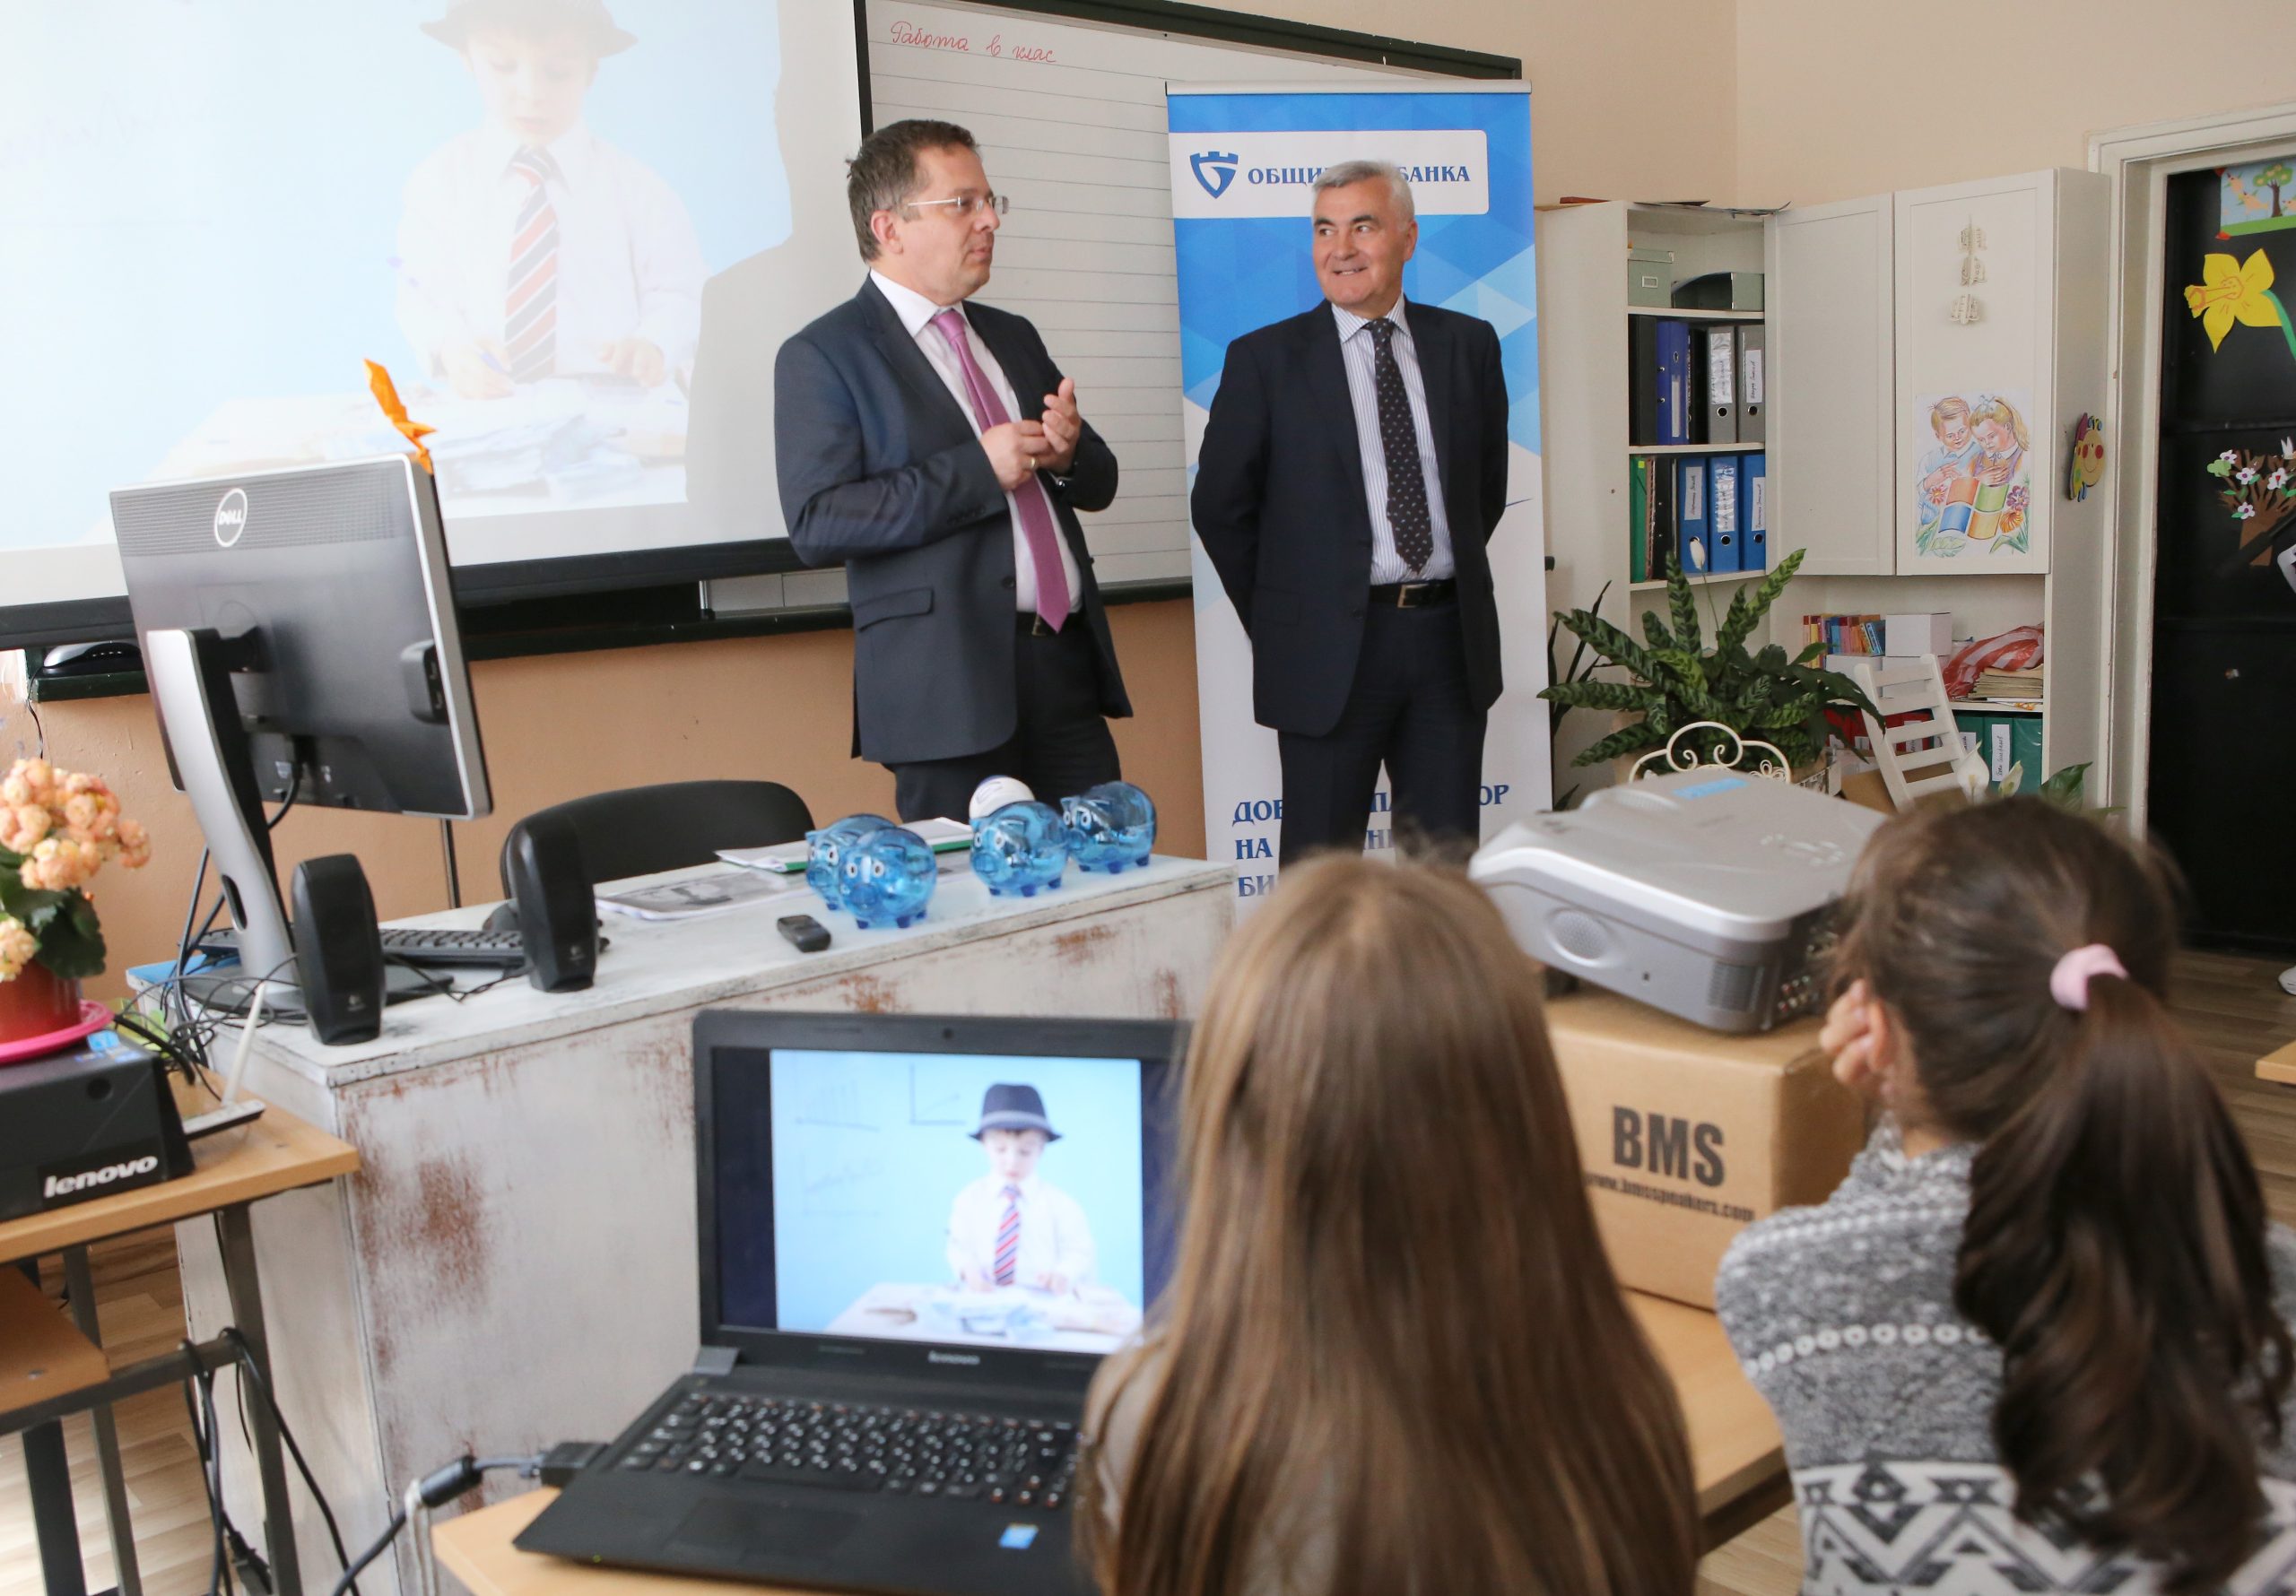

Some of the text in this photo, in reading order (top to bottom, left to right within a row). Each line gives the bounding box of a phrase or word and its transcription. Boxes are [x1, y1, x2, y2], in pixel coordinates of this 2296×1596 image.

[891, 21, 969, 52] Работа
[1248, 167, 1326, 186] ОБЩИ
[218, 508, 244, 526] DELL
[1232, 799, 1283, 827] ДОБ
[1235, 838, 1274, 860] НА
[1238, 875, 1275, 898] БИ
[1613, 1106, 1725, 1188] BMS
[44, 1156, 158, 1199] lenovo
